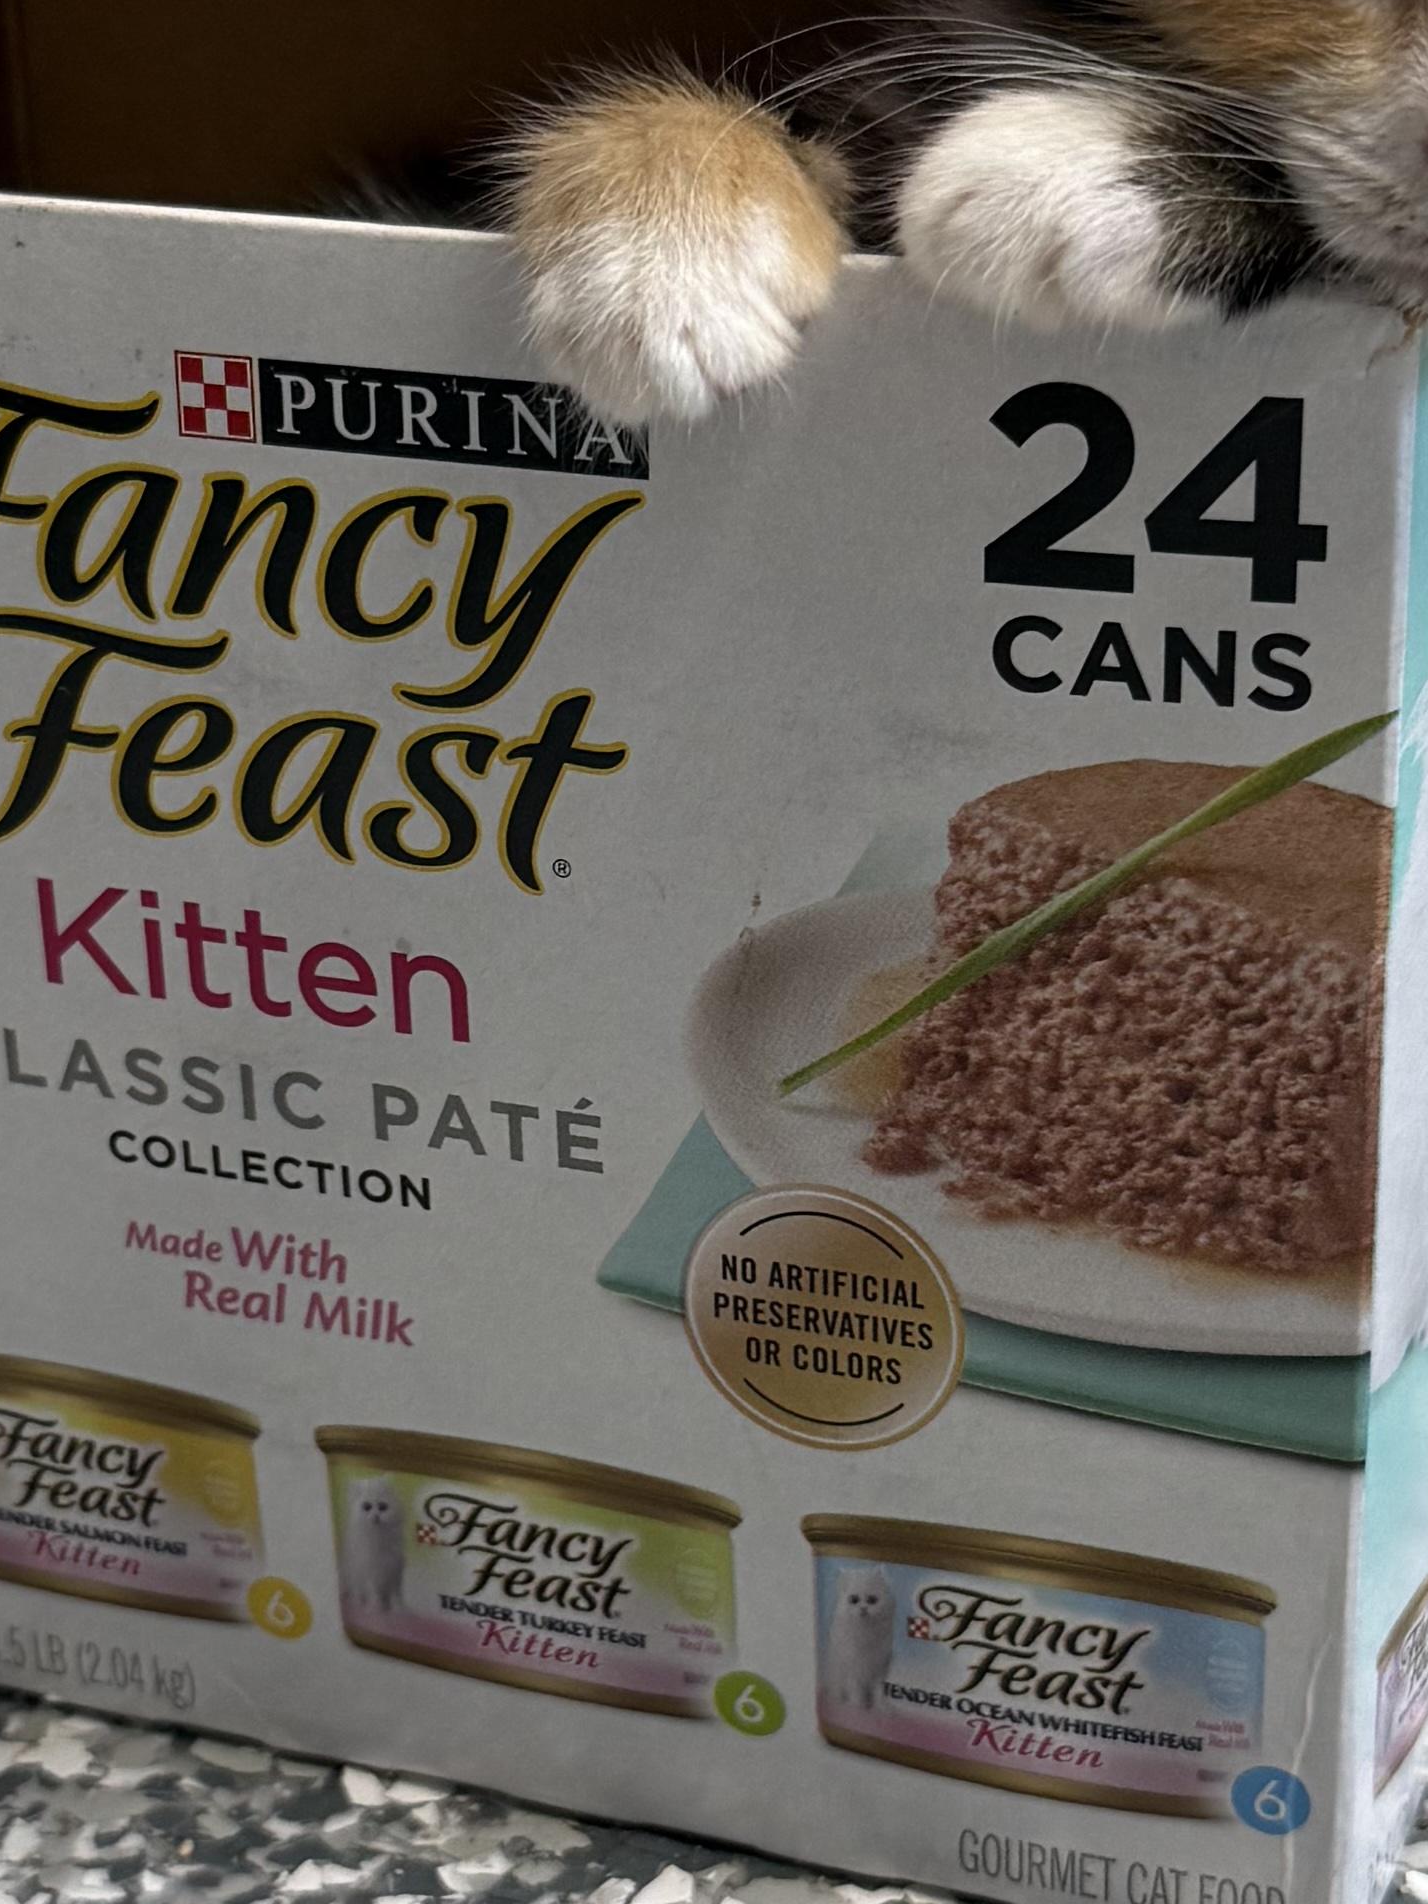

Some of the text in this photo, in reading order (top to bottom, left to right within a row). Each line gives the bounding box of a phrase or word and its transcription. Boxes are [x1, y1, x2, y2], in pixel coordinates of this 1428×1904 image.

[272, 370, 634, 466] PURINA
[983, 380, 1329, 605] 24
[991, 613, 1314, 712] CANS
[35, 877, 472, 1044] Kitten
[372, 1082, 606, 1175] PATÉ
[108, 1129, 433, 1211] COLLECTION
[124, 1220, 349, 1284] Made With
[720, 1253, 926, 1310] NO ARTIFICIAL
[182, 1270, 416, 1348] Real Milk
[713, 1291, 934, 1351] PRESERVATIVES
[745, 1336, 902, 1386] OR COLORS
[6, 1458, 168, 1527] Feast
[28, 1530, 142, 1575] Kitten
[424, 1493, 634, 1579] Fancy
[266, 1589, 295, 1629] 6
[458, 1544, 632, 1620] Feast
[438, 1594, 514, 1624] TENDER
[517, 1609, 595, 1640] TURKEY
[598, 1626, 648, 1649] FEAST
[477, 1619, 600, 1669] Kitten
[918, 1585, 1151, 1673] Fancy
[33, 1628, 69, 1676] LB
[76, 1640, 146, 1692] (2.04
[152, 1654, 198, 1711] kg)
[733, 1683, 766, 1723] 6
[951, 1640, 1144, 1716] Feast
[883, 1681, 953, 1711] TENDER
[957, 1698, 1037, 1728] OCEAN
[1038, 1712, 1156, 1746] WHITEFISH
[1157, 1732, 1205, 1753] FEAST
[967, 1718, 1104, 1769] Kitten
[1253, 1779, 1287, 1822] 6
[957, 1828, 1116, 1904] GOURMET
